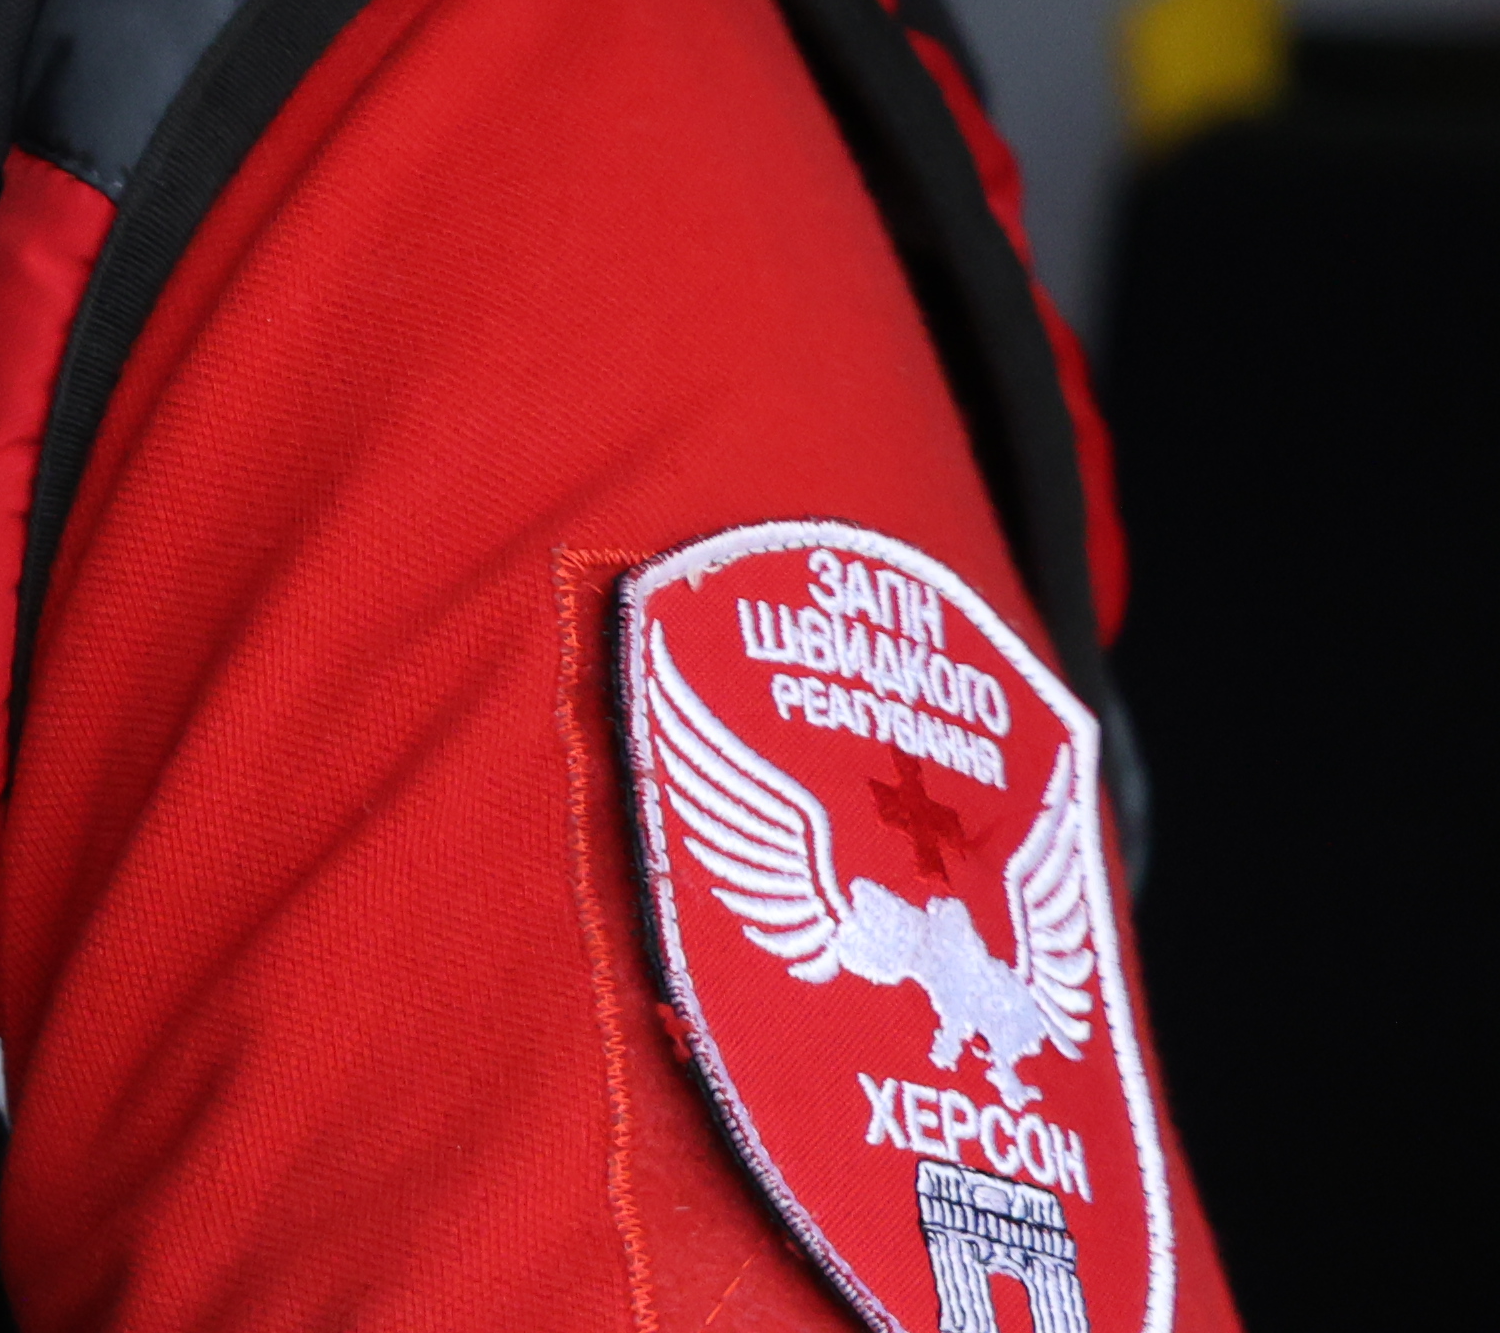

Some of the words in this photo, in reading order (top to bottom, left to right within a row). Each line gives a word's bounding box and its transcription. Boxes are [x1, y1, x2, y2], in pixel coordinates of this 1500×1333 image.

[736, 597, 1011, 737] ШВИДКОГО
[770, 672, 1008, 791] РЕАГУВАННЯ
[856, 1071, 1094, 1204] ХЕРСОН
